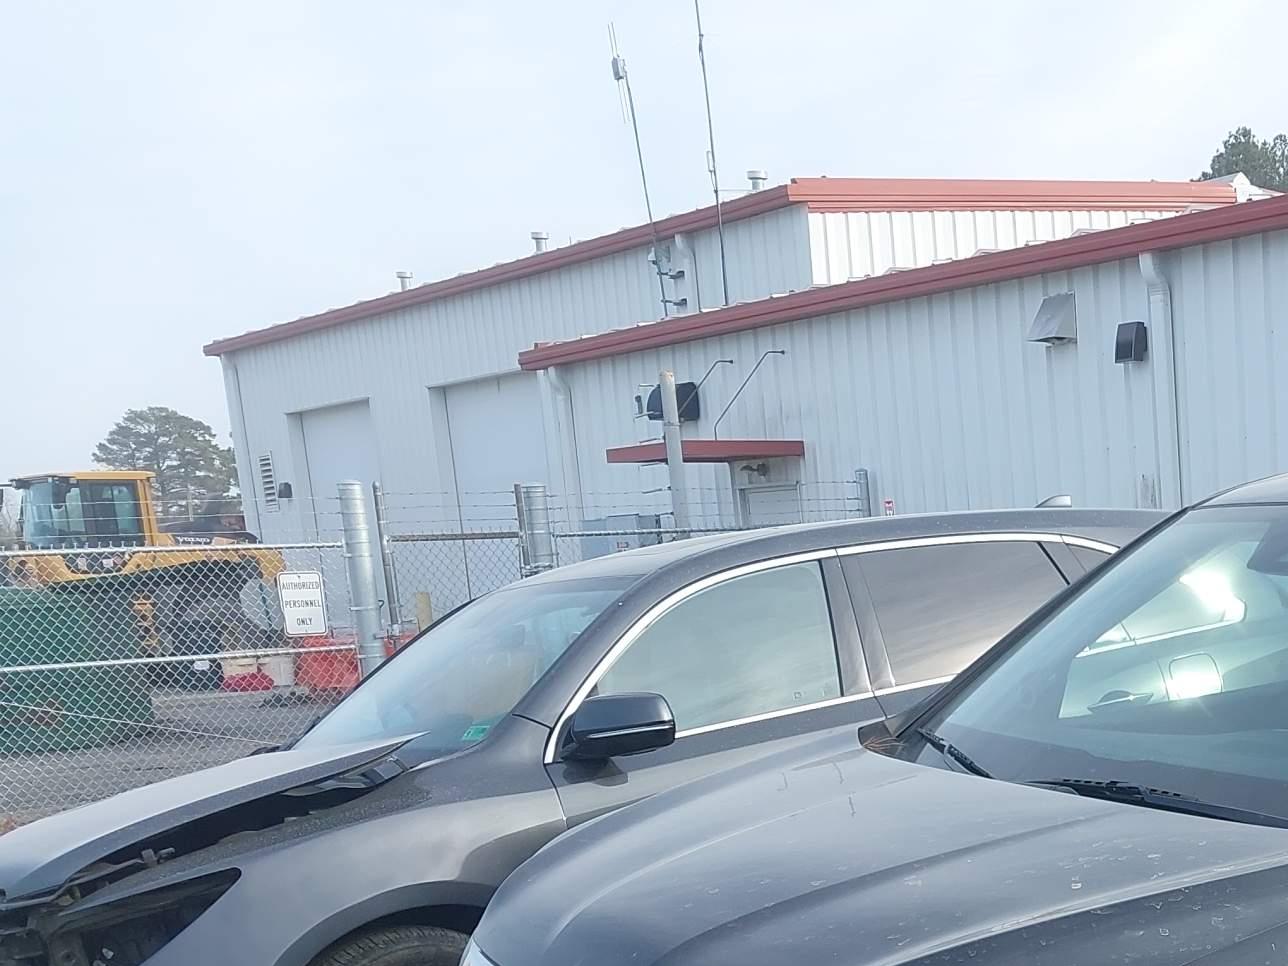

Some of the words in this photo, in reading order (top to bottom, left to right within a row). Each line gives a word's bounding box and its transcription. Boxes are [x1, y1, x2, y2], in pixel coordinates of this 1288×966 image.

[281, 581, 320, 590] AUTHORIZED
[284, 600, 321, 608] PERSONNEL
[296, 617, 313, 626] ONLY
